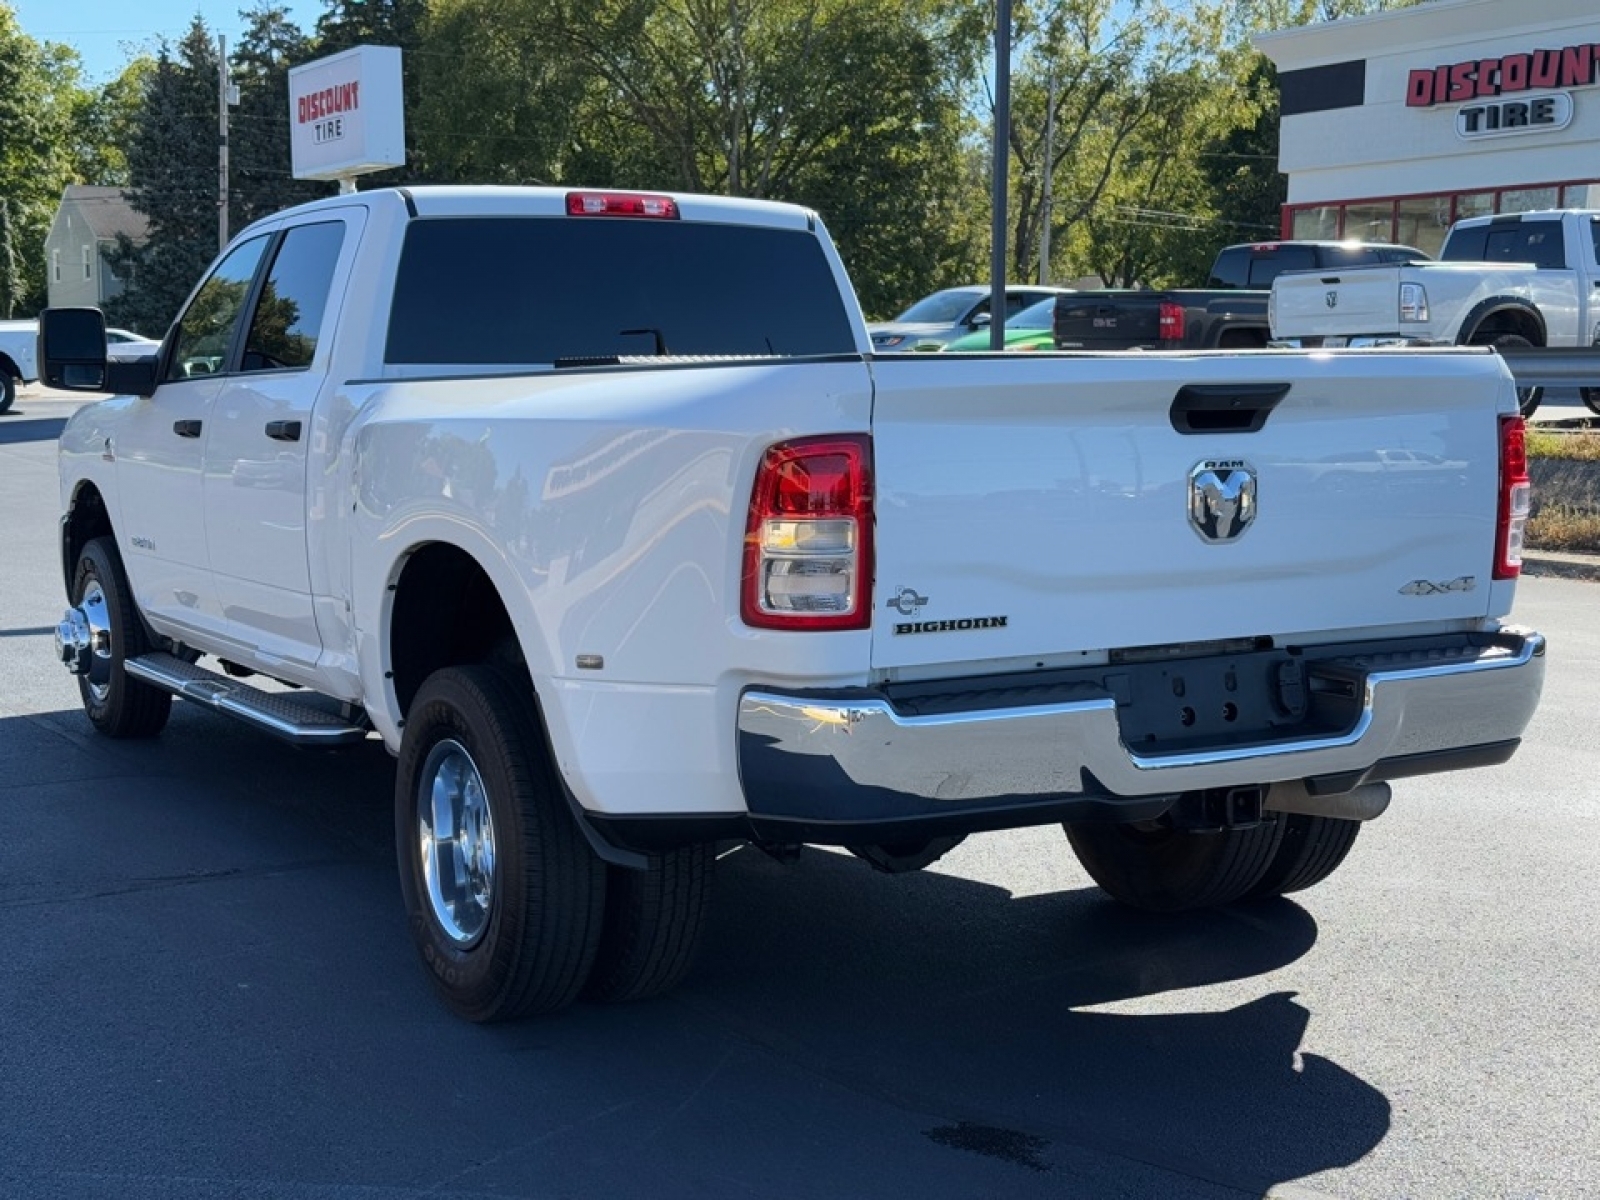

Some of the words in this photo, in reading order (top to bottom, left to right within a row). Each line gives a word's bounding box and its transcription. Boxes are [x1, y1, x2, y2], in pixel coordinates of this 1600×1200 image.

[1405, 42, 1600, 107] DISCOUN
[298, 80, 359, 124] DISCOUNT
[1459, 98, 1555, 132] TIRE
[315, 119, 342, 141] TIRE
[1204, 460, 1244, 469] RAM
[893, 616, 1008, 635] BIGHORN
